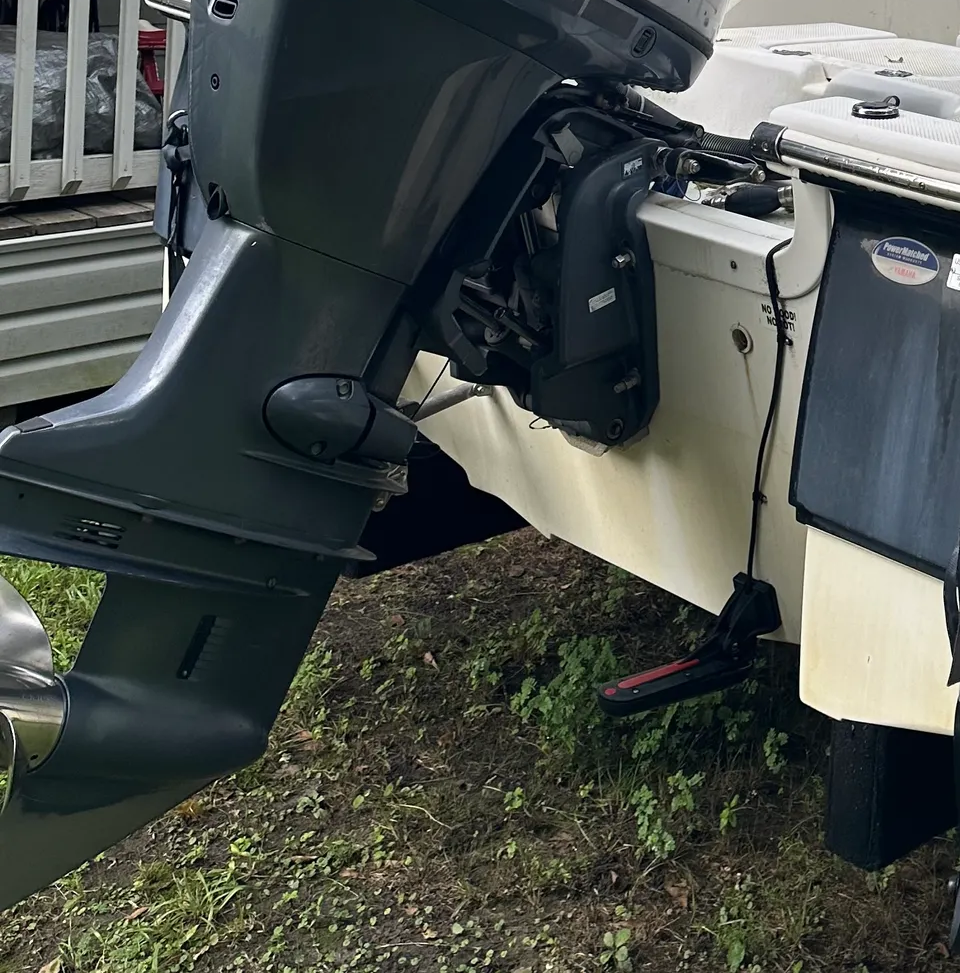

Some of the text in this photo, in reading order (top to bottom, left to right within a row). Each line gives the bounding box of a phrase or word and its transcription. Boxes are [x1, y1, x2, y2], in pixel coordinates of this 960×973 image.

[883, 242, 930, 261] PowerMatched
[894, 265, 916, 279] YAMAHA
[761, 303, 797, 321] NO OOD!
